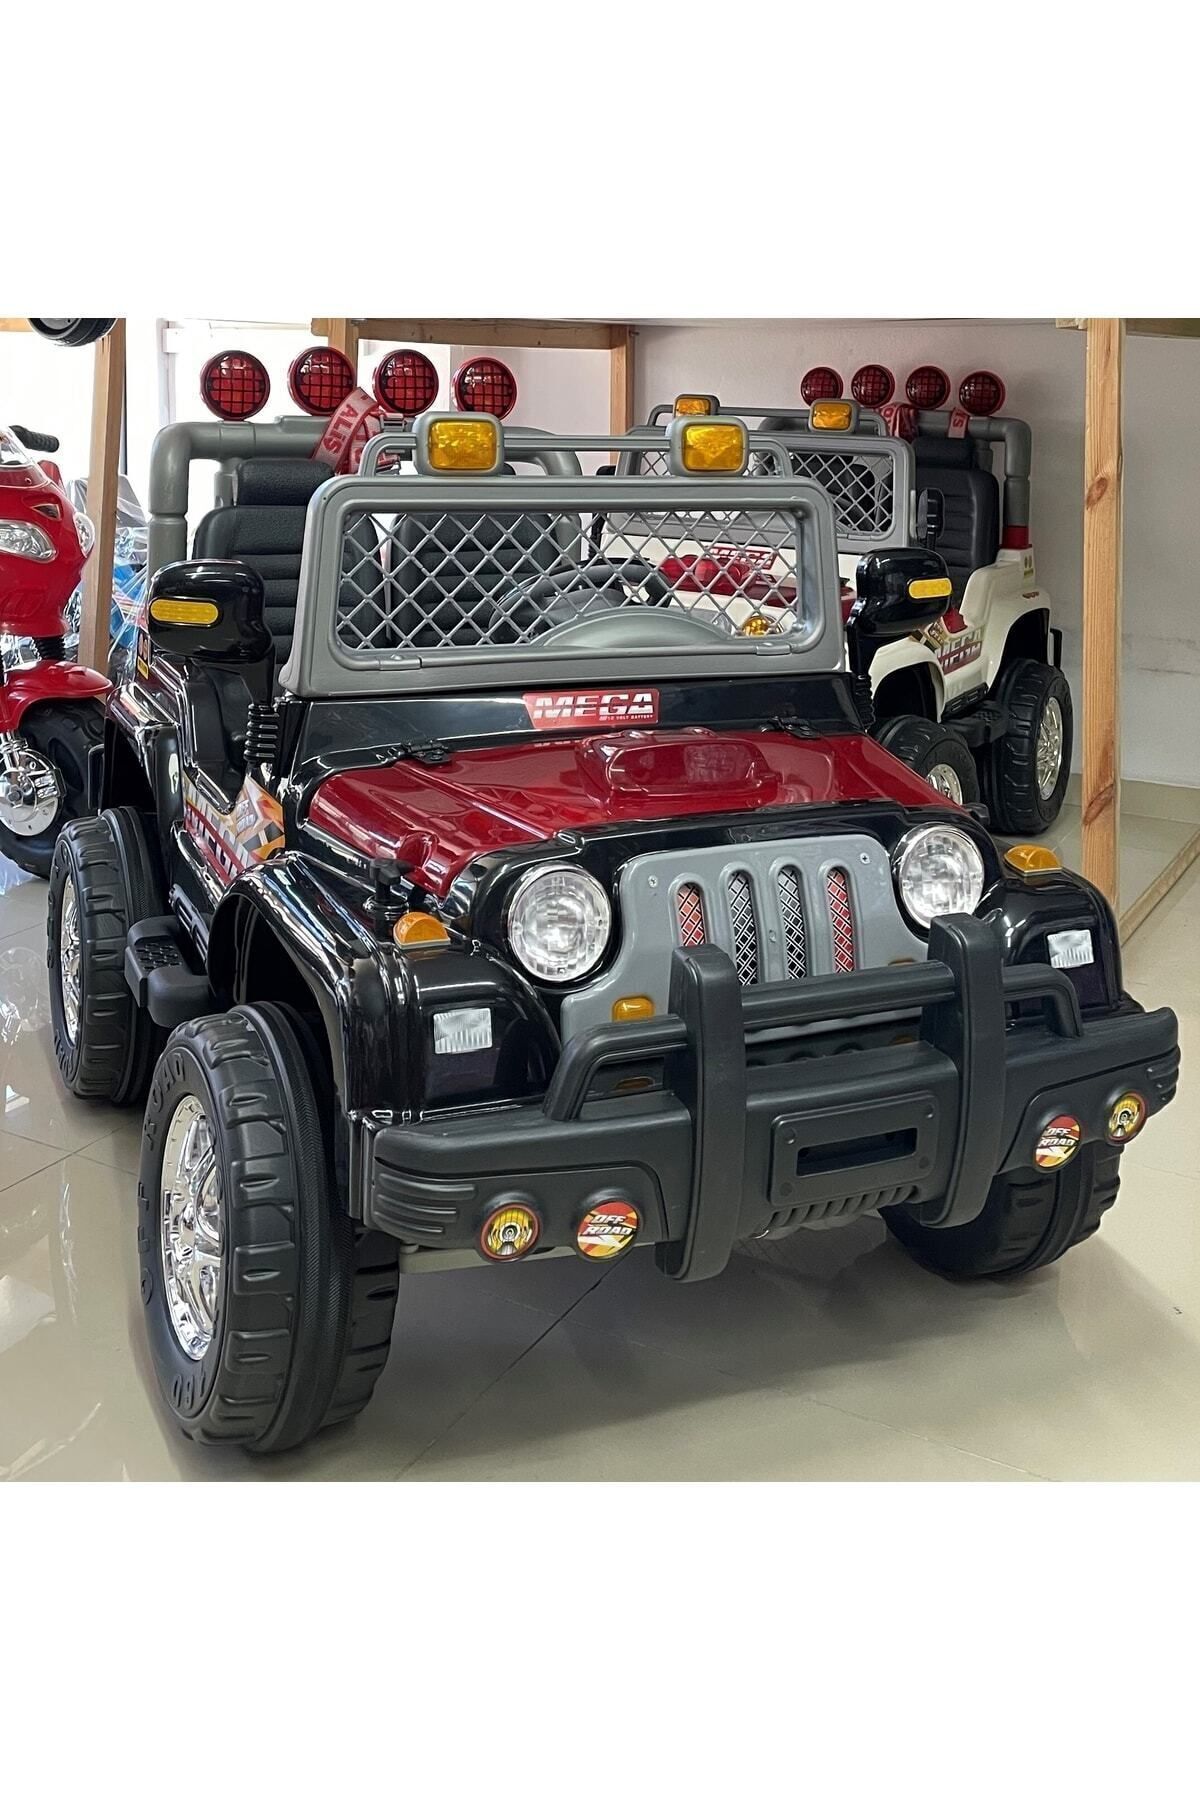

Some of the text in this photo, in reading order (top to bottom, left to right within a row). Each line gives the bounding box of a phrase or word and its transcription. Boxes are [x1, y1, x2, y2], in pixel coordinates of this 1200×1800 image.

[533, 693, 654, 719] MEGA
[144, 1052, 185, 1150] ROAD
[1046, 1127, 1072, 1136] OFF
[1038, 1138, 1076, 1147] ROAD
[591, 1214, 627, 1224] OFF
[582, 1226, 633, 1235] ROAD
